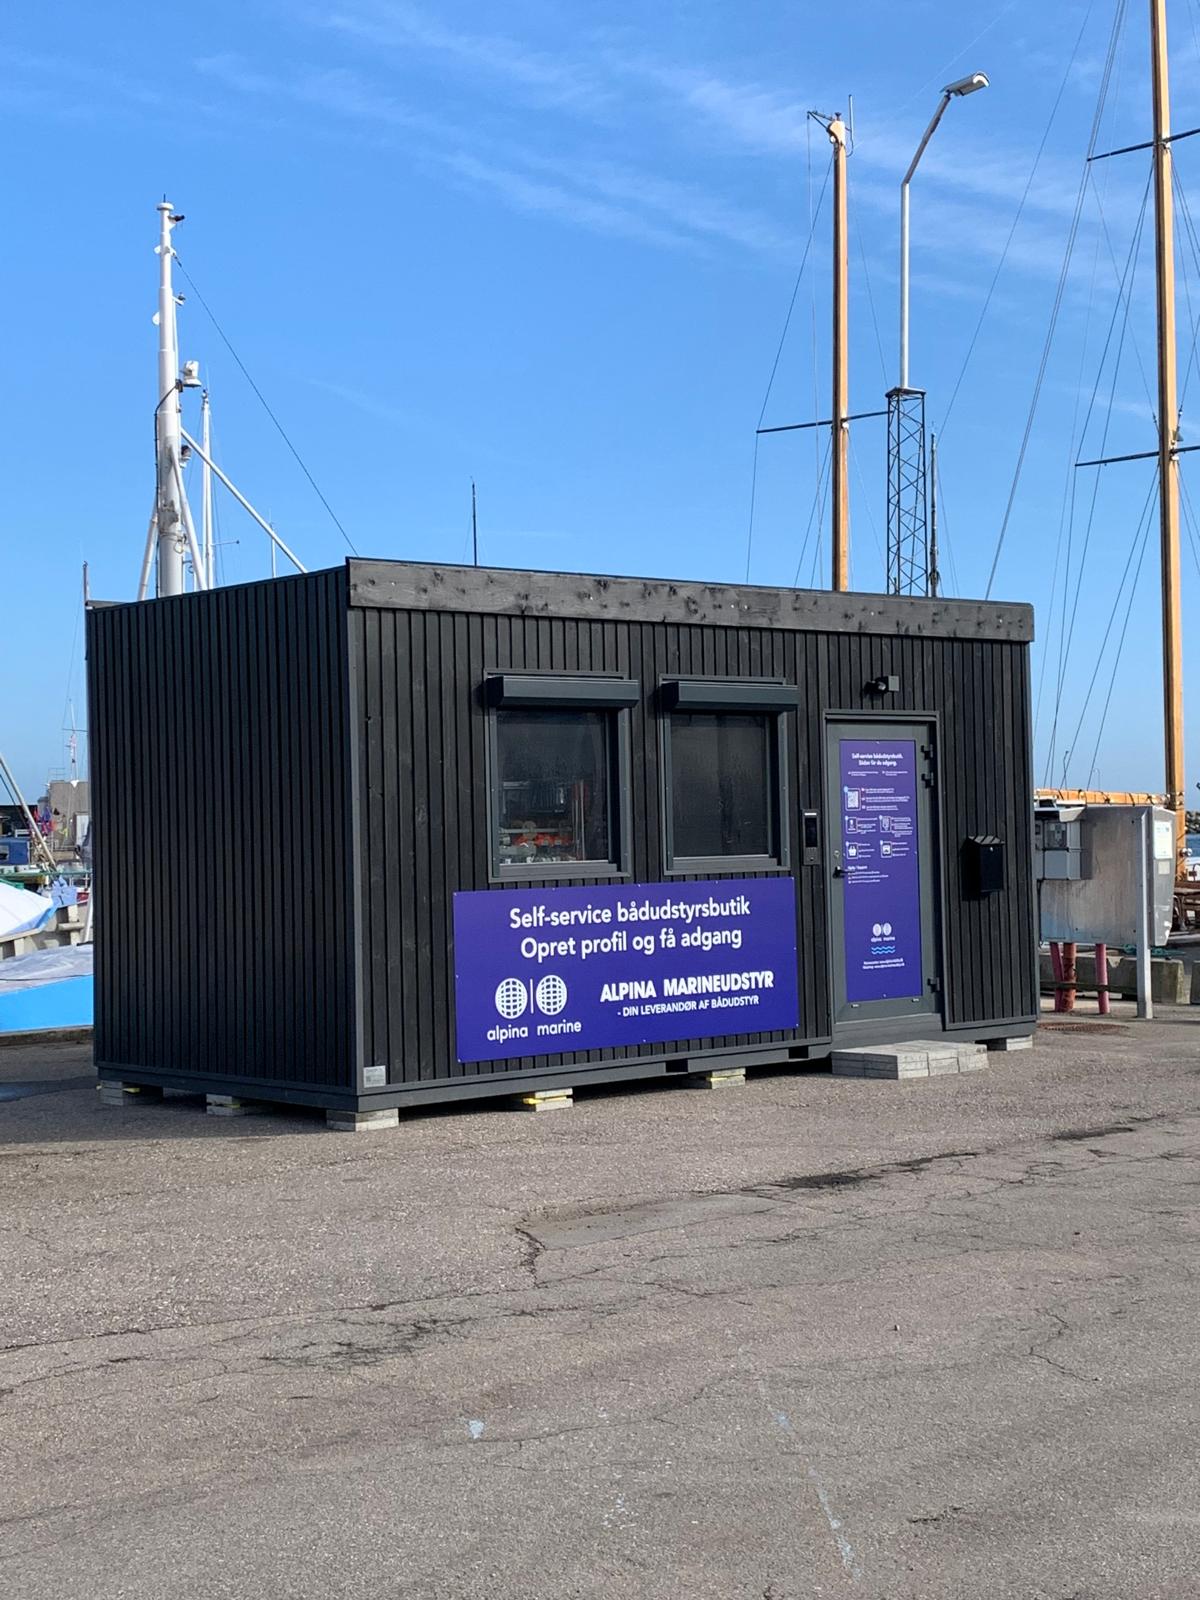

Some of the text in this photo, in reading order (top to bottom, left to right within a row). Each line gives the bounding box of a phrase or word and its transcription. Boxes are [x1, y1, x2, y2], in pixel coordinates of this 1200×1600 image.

[509, 895, 750, 929] Self-service bådudstyrsbutik
[520, 926, 742, 963] Opret profil og få adgang
[600, 970, 774, 1003] ALPINA MARINEUDSTYR
[622, 1005, 639, 1017] DIN
[640, 1001, 697, 1016] LEVERANDØR
[698, 999, 711, 1010] AF
[711, 995, 759, 1009] BÅDUDSTYR
[486, 1019, 582, 1044] alpina marine
